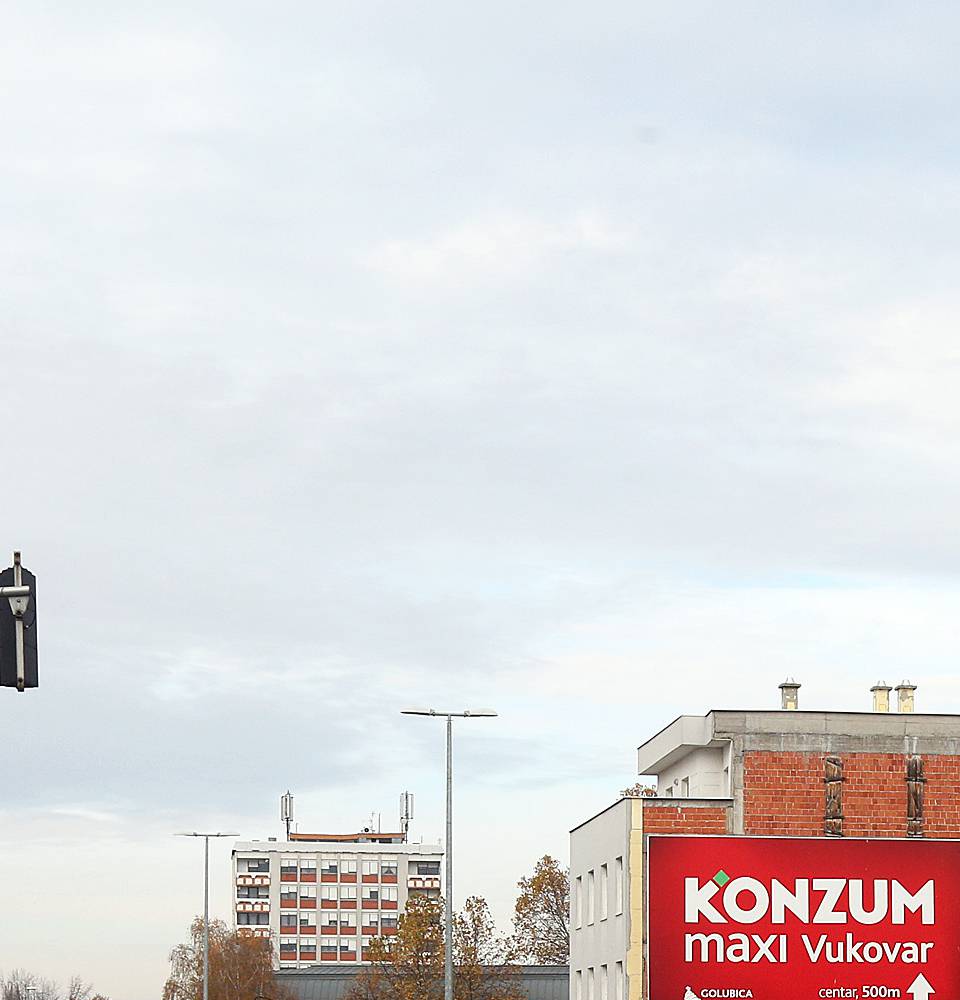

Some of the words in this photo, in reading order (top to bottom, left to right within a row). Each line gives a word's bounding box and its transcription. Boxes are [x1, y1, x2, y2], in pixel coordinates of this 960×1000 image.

[684, 876, 936, 925] KONZUM
[684, 932, 788, 963] maxi
[801, 932, 934, 964] Vukovar
[700, 989, 754, 998] GOLUBICA
[818, 986, 859, 1000] centar,
[861, 986, 901, 998] 500m
